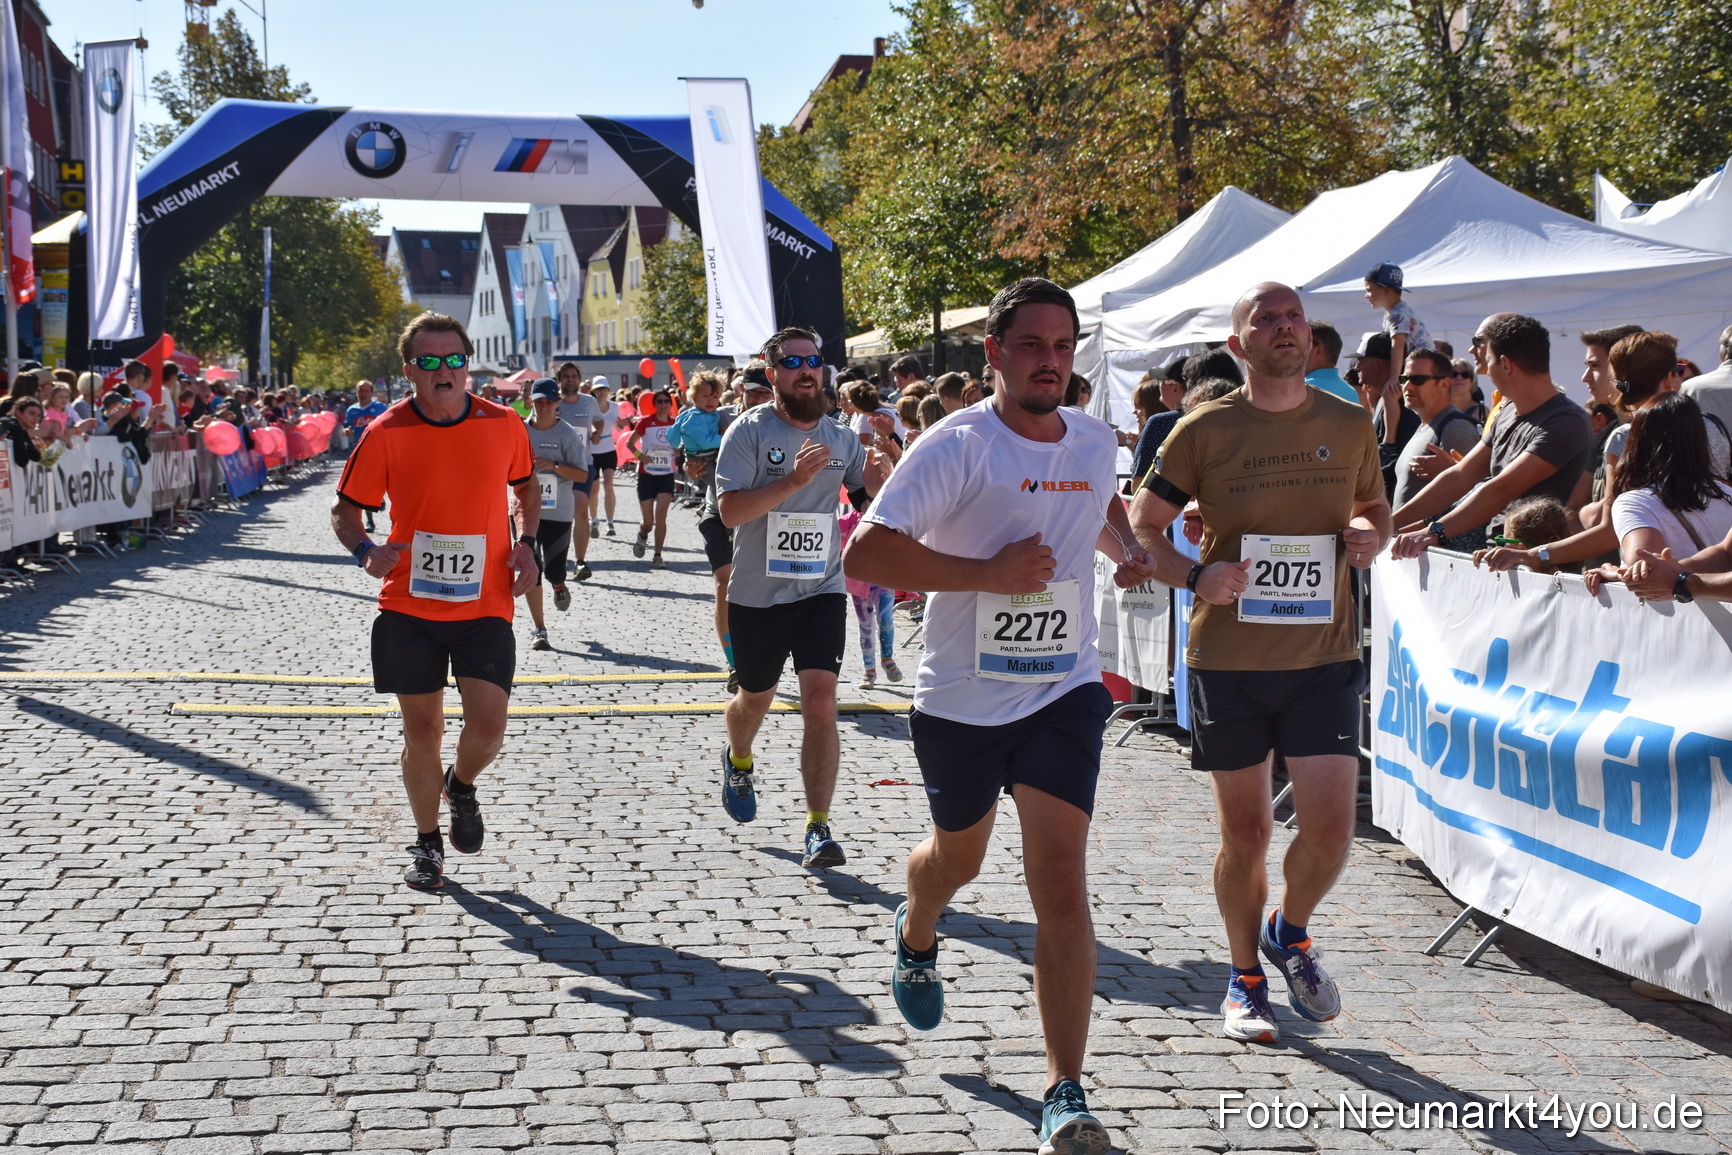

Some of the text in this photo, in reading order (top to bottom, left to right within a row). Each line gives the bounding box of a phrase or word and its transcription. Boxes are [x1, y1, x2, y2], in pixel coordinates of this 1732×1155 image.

[350, 121, 401, 141] BMW
[152, 161, 241, 218] NEUMARKT
[1244, 451, 1313, 470] elements
[1041, 480, 1095, 492] KLEBL
[1229, 485, 1247, 494] BAD
[1260, 478, 1301, 490] HEIZUNG
[1314, 475, 1347, 485] ENERGIE
[788, 519, 817, 527] BOCK
[432, 540, 465, 549] BOCK
[777, 531, 823, 552] 2052
[1271, 544, 1311, 554] BOCK
[422, 552, 474, 574] 2112
[790, 562, 813, 572] Heiko
[1254, 560, 1321, 588] 2075
[439, 585, 455, 595] Jan
[1011, 592, 1054, 605] BOCK
[1270, 603, 1305, 615] André
[994, 609, 1068, 642] 2272
[1024, 645, 1054, 653] Neumarkt
[1007, 659, 1055, 672] Markus
